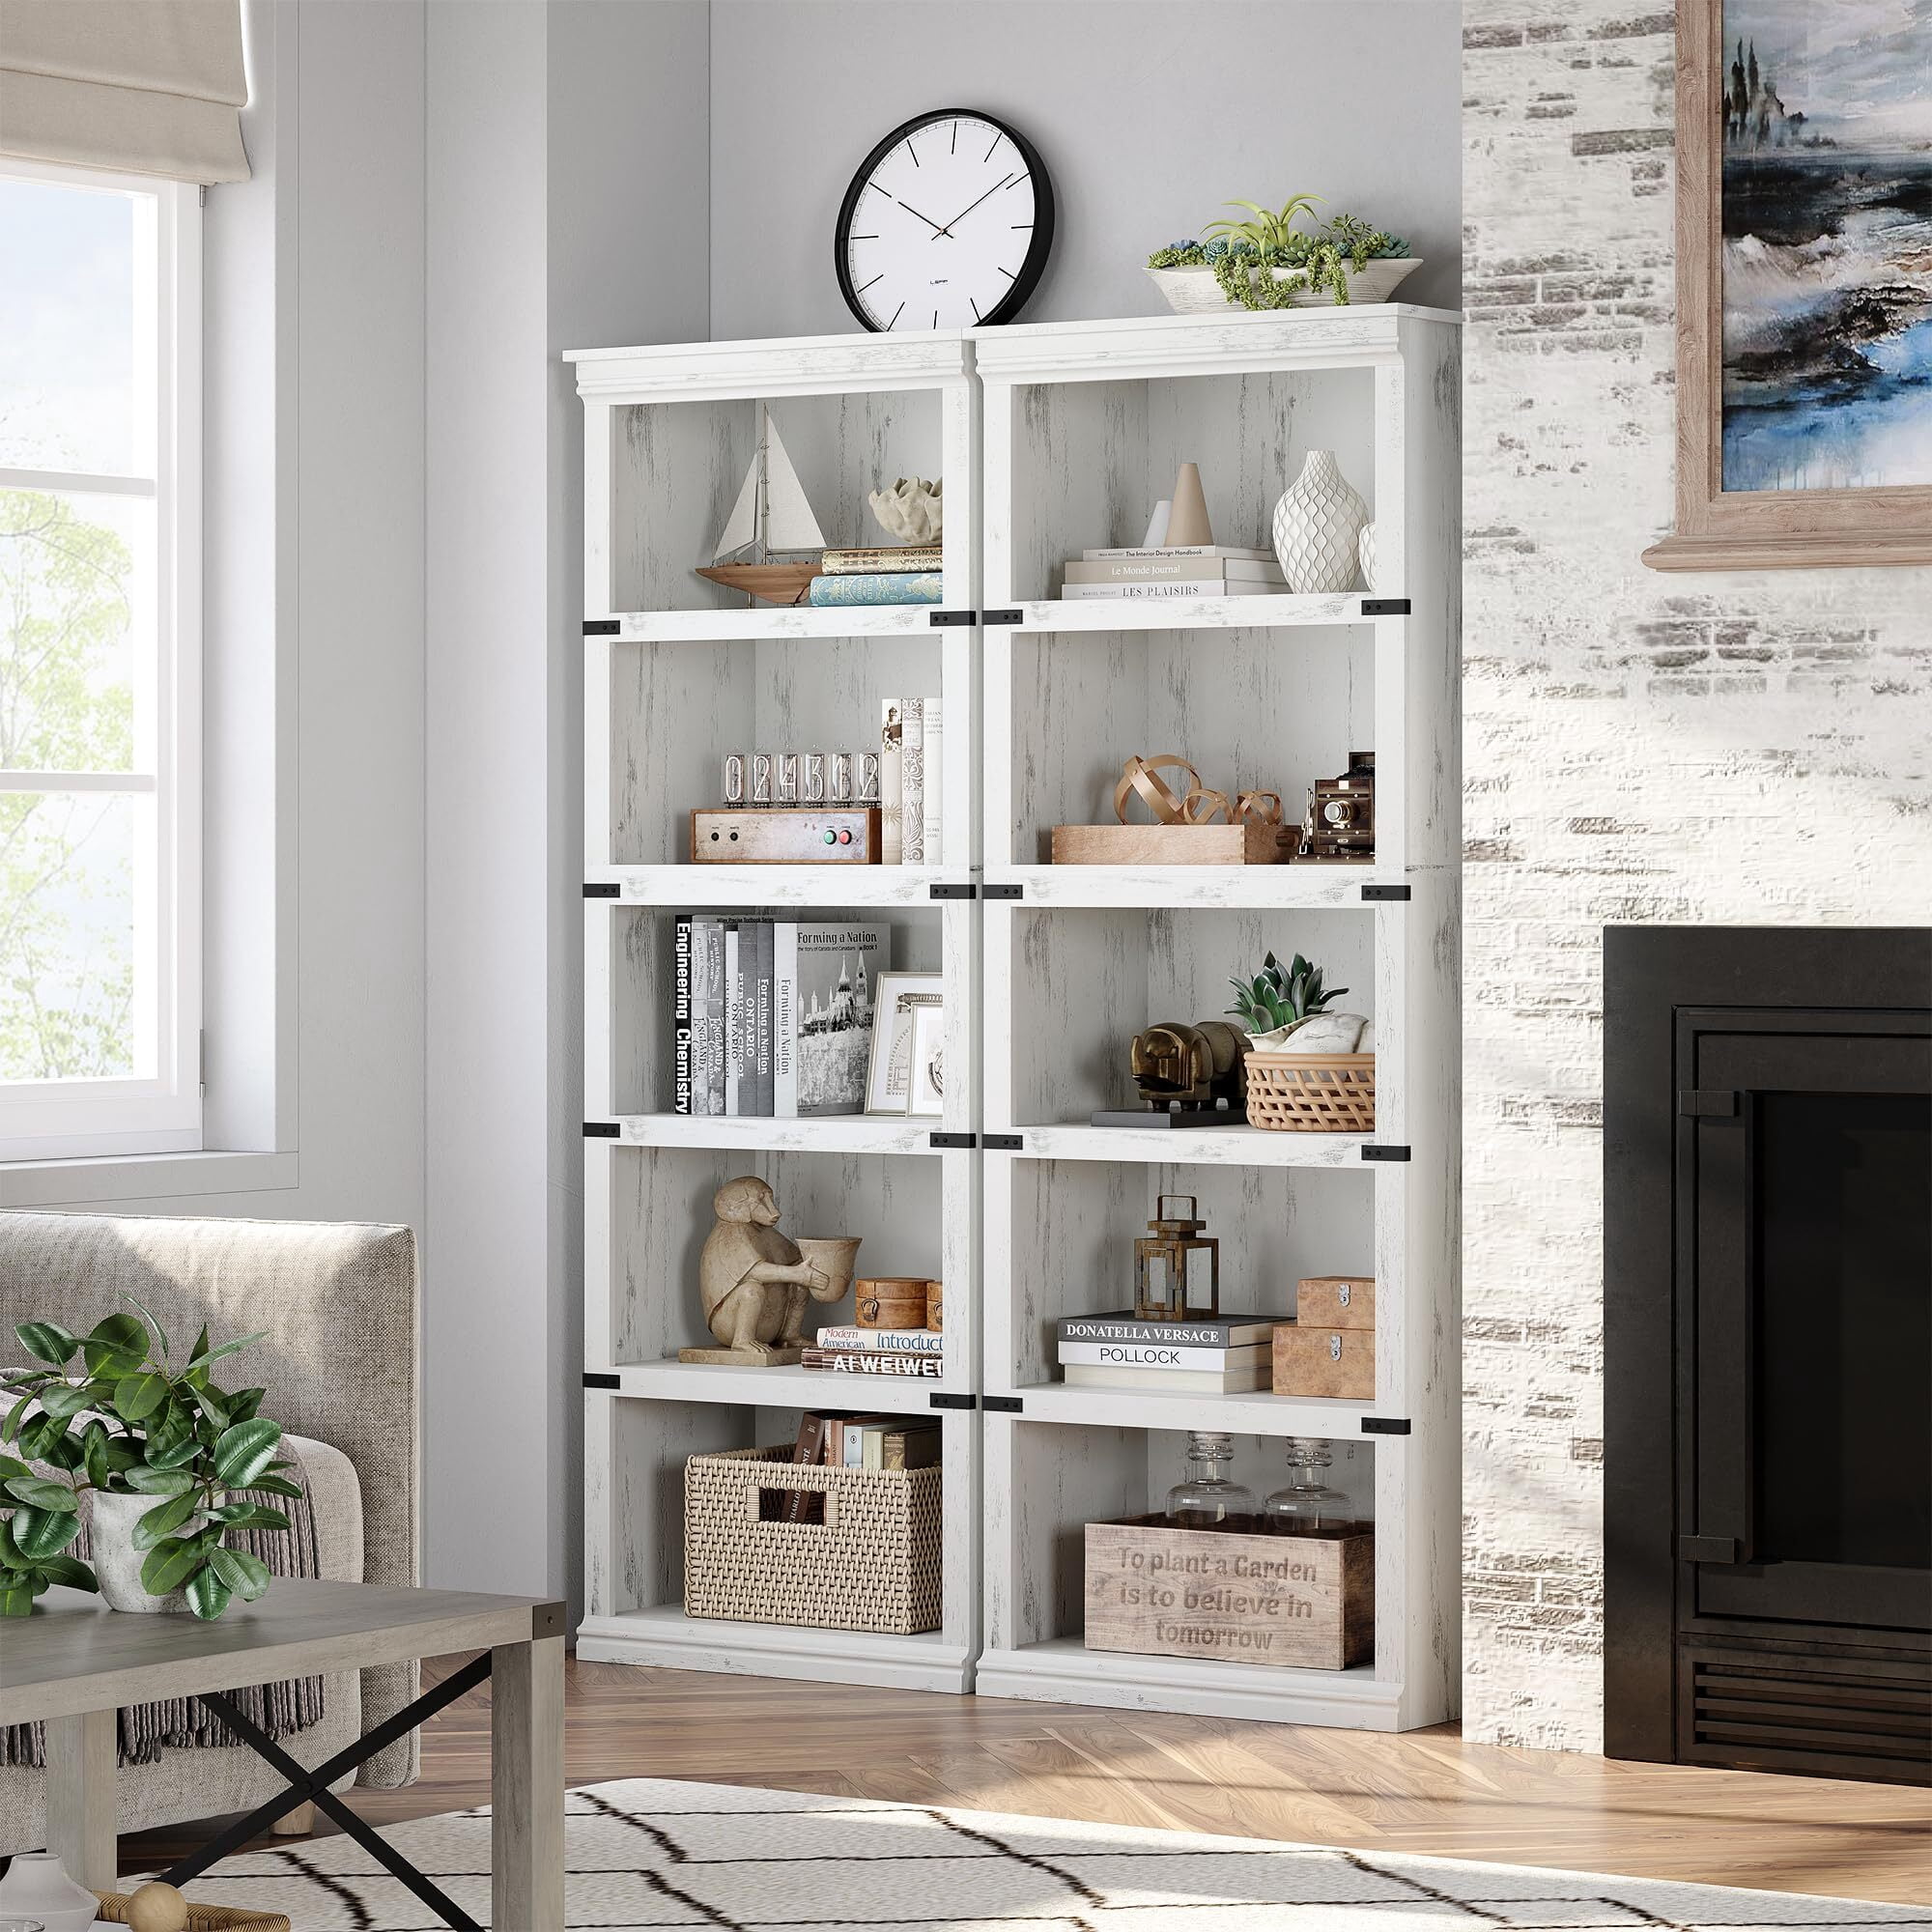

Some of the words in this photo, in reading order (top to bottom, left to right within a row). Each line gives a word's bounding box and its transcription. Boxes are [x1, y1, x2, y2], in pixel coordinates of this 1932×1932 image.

[1112, 567, 1121, 576] Le
[1122, 566, 1150, 575] Monde
[1151, 565, 1180, 574] Journal
[1122, 587, 1142, 597] LES
[1148, 585, 1199, 596] PLAISIRS
[712, 937, 721, 963] PUBLIC
[797, 931, 838, 945] Forming
[839, 933, 845, 943] a
[847, 930, 877, 943] Nation
[675, 923, 692, 1019] Engineering
[760, 979, 769, 1026] Forming
[780, 980, 791, 1026] Forming
[708, 1016, 724, 1065] ENGLAND
[746, 997, 754, 1057] ONTARIO
[675, 1028, 692, 1114] Chemistry
[760, 1038, 769, 1074] Nation
[781, 1038, 791, 1075] Nation
[822, 1338, 866, 1350] American
[825, 1328, 859, 1339] Modern
[1066, 1324, 1151, 1340] DONATELLA
[1153, 1328, 1219, 1343] VERSACE
[1099, 1348, 1180, 1364] POLLOCK
[1118, 1547, 1145, 1569] To
[1151, 1549, 1208, 1576] plant
[1215, 1557, 1228, 1576] a
[1235, 1554, 1317, 1582] Garden
[1120, 1582, 1141, 1605] is
[1149, 1585, 1176, 1607] to
[1183, 1587, 1280, 1615] believe
[1287, 1594, 1313, 1618] in
[1155, 1619, 1273, 1650] tomorrow
